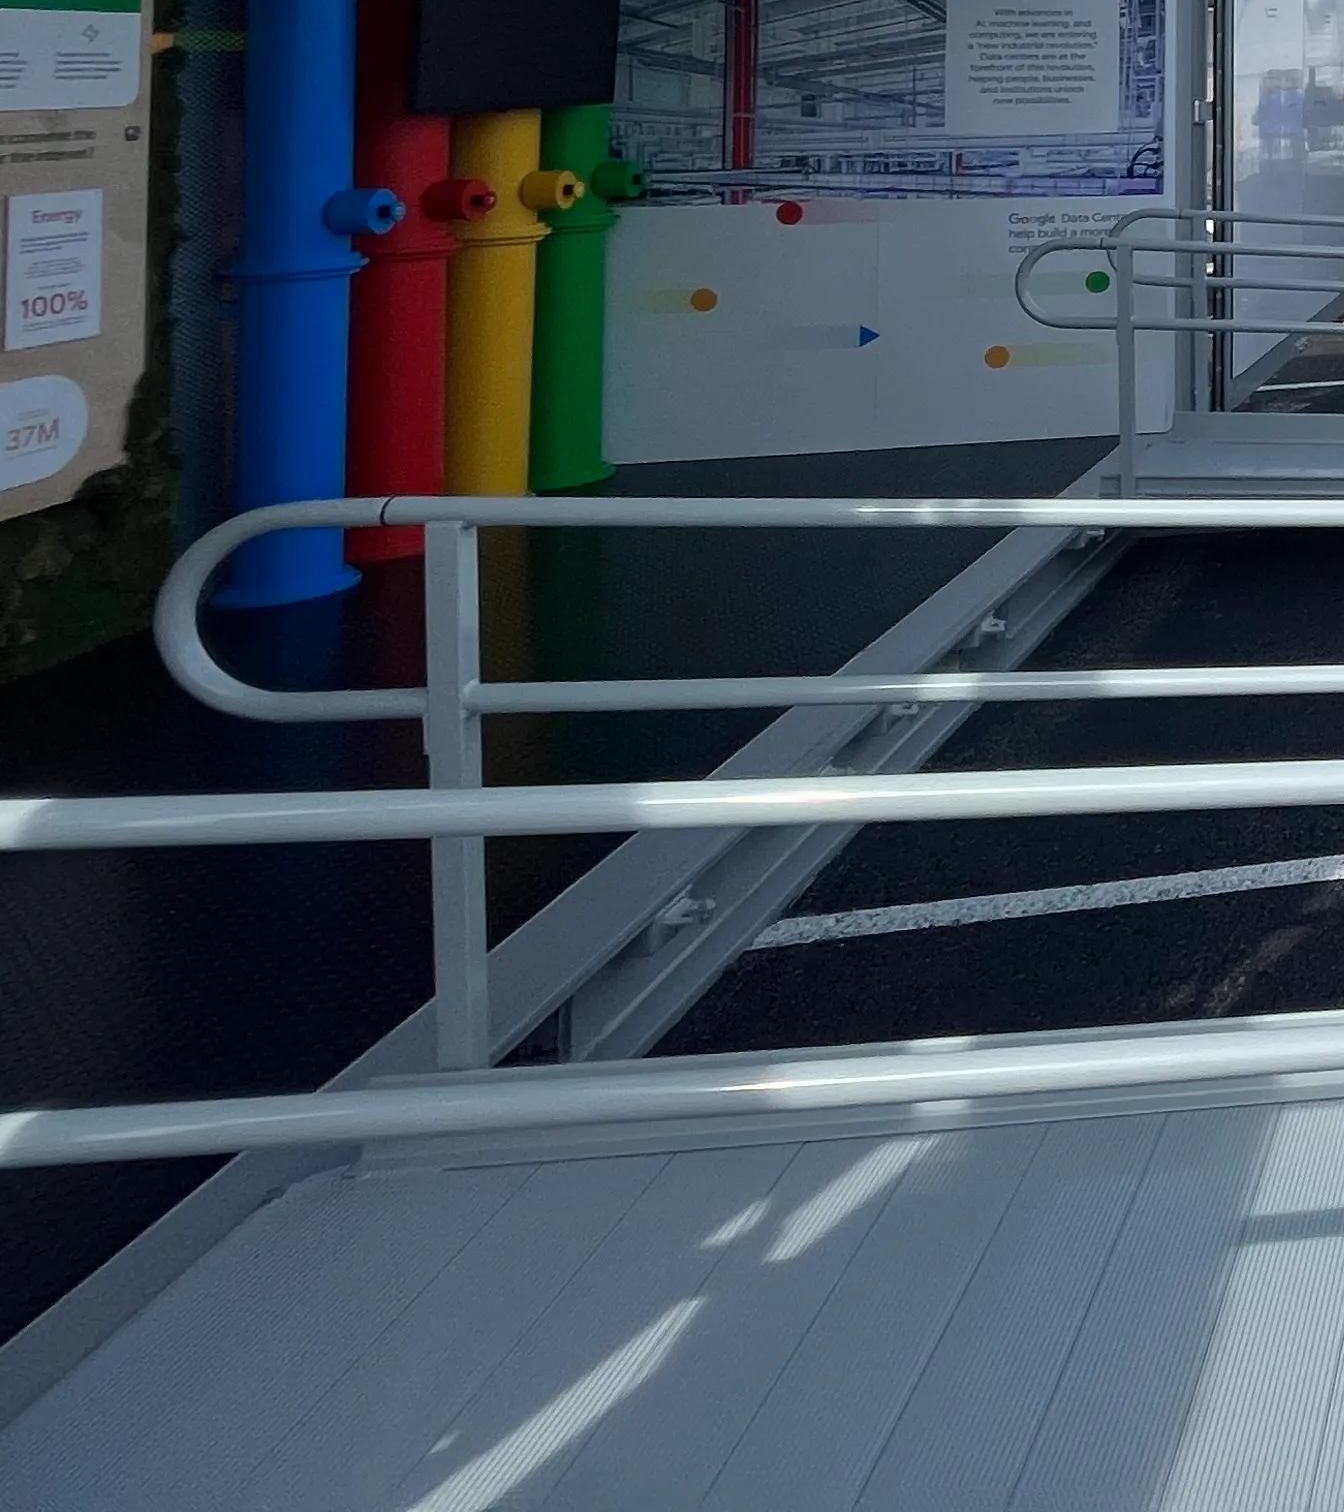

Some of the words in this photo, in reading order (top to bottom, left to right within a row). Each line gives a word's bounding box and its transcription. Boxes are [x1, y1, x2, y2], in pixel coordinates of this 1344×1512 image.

[989, 20, 1030, 28] machine
[1073, 20, 1092, 28] and
[1008, 213, 1056, 227] Google
[1061, 213, 1089, 224] Data
[1008, 229, 1035, 240] help
[1038, 228, 1067, 238] build
[21, 290, 88, 320] 100%
[7, 417, 60, 452] 37M
